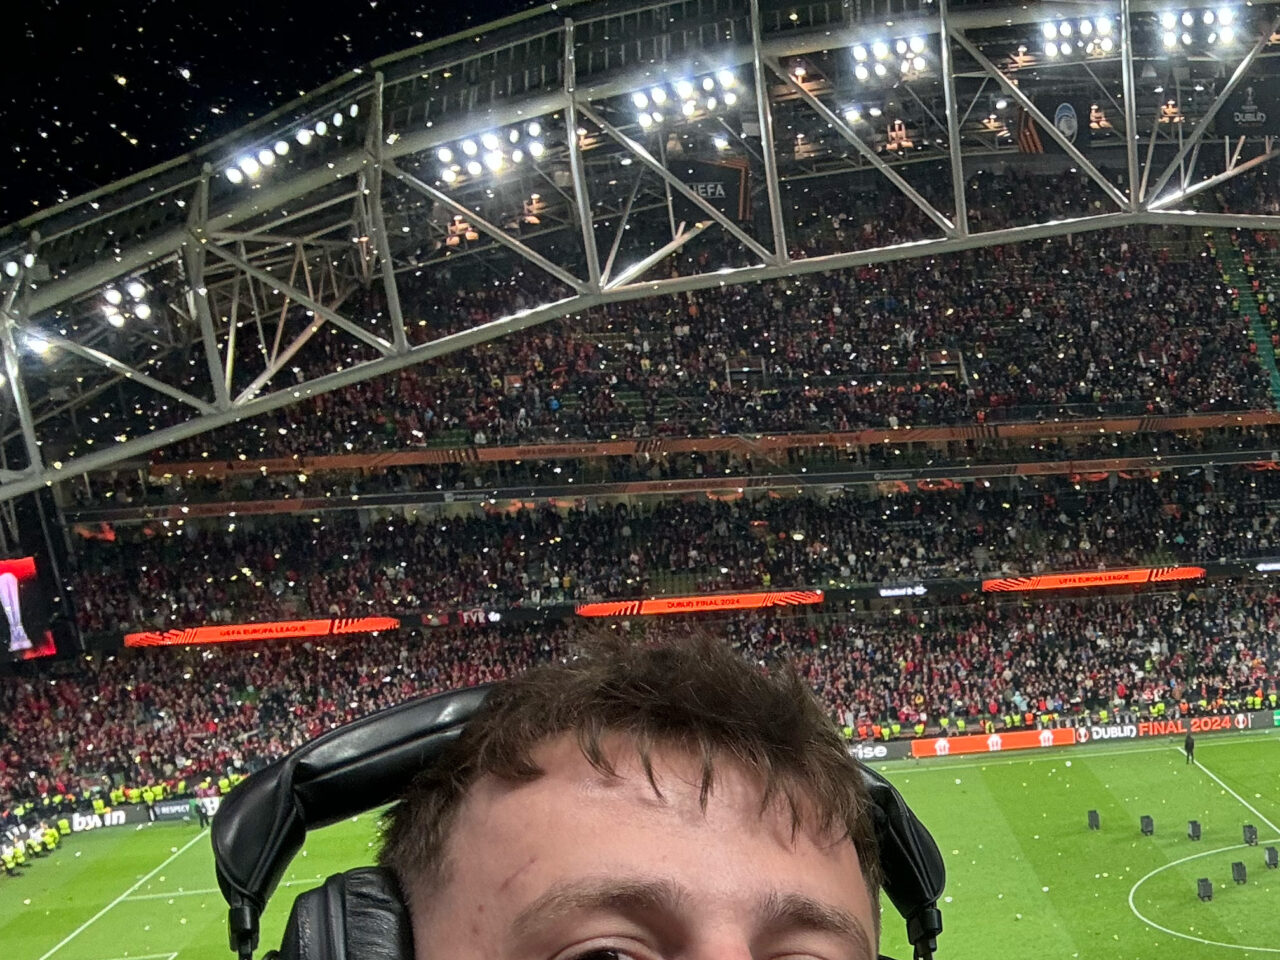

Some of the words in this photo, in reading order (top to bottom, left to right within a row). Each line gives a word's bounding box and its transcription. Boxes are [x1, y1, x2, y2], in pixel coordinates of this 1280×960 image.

[667, 601, 694, 609] DUBLIN
[243, 627, 273, 635] EUROPA
[275, 625, 306, 633] LEAGUE
[1092, 725, 1137, 741] DUBLIN
[1139, 719, 1187, 737] FINAL
[1190, 715, 1232, 733] 2024
